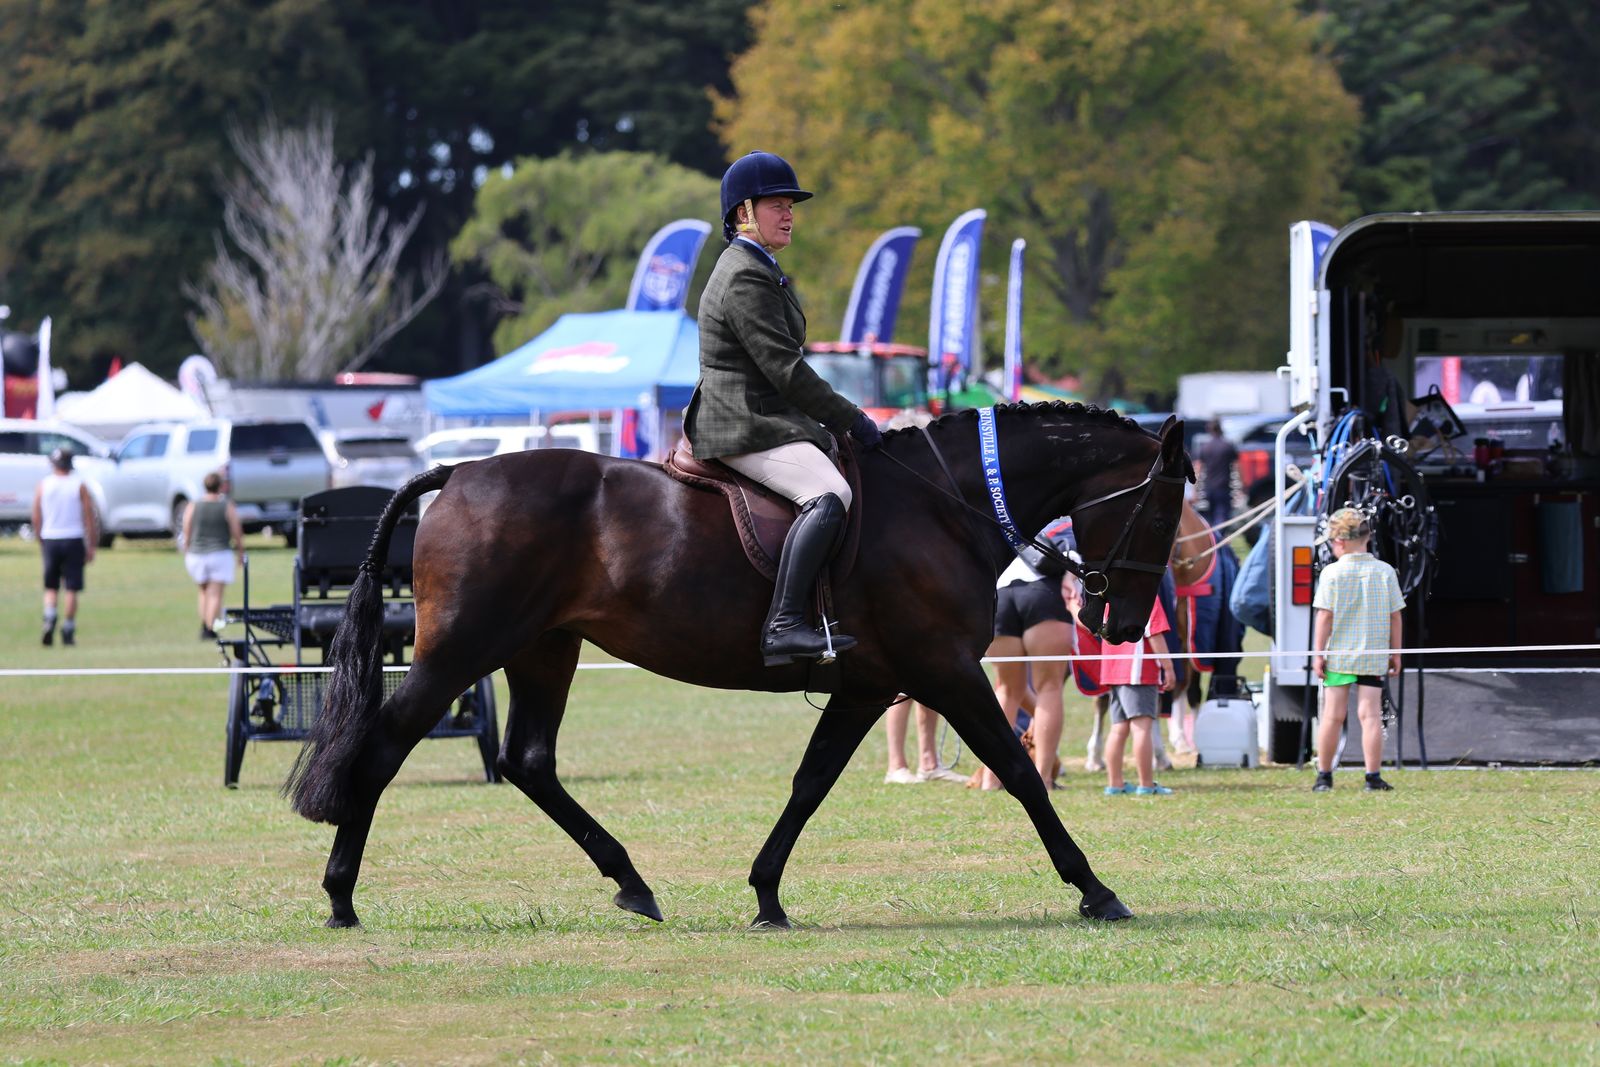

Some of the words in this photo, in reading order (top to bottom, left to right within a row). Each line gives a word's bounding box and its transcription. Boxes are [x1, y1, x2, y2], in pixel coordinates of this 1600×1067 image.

[985, 457, 996, 466] A.
[986, 468, 998, 476] &
[988, 477, 999, 485] P.
[990, 486, 1011, 525] SOCIETY
